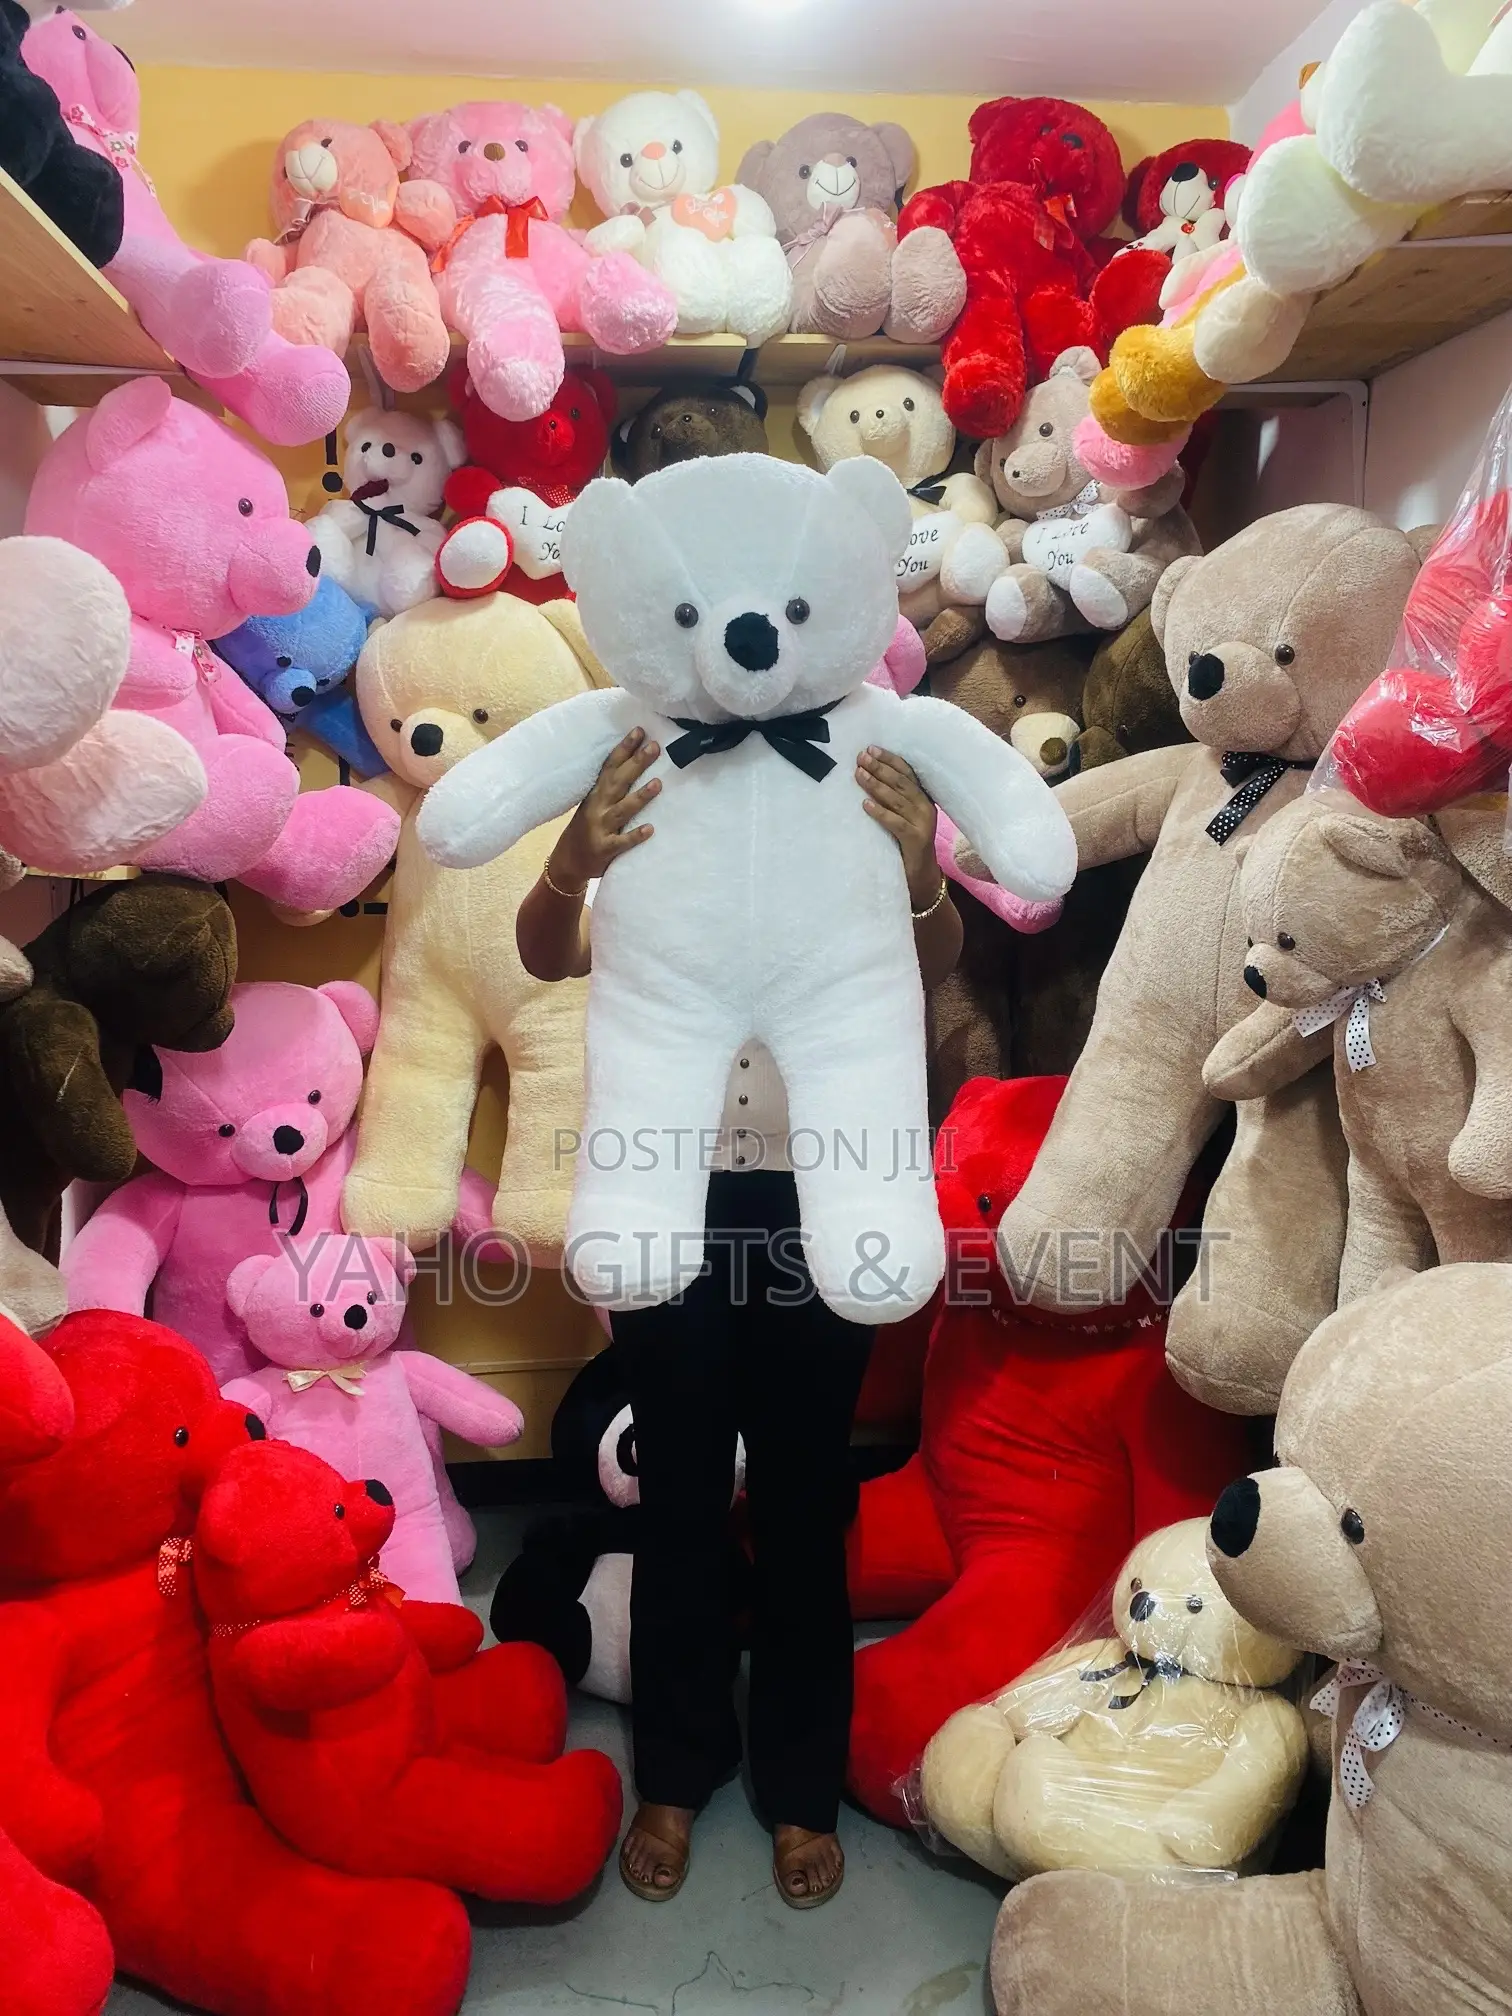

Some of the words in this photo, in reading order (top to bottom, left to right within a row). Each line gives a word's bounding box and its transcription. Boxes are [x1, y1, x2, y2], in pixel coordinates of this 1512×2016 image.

[520, 506, 528, 525] I
[541, 516, 566, 532] Lo
[909, 528, 940, 546] ove
[538, 542, 561, 561] Yo
[1047, 546, 1075, 571] You
[896, 556, 929, 577] You
